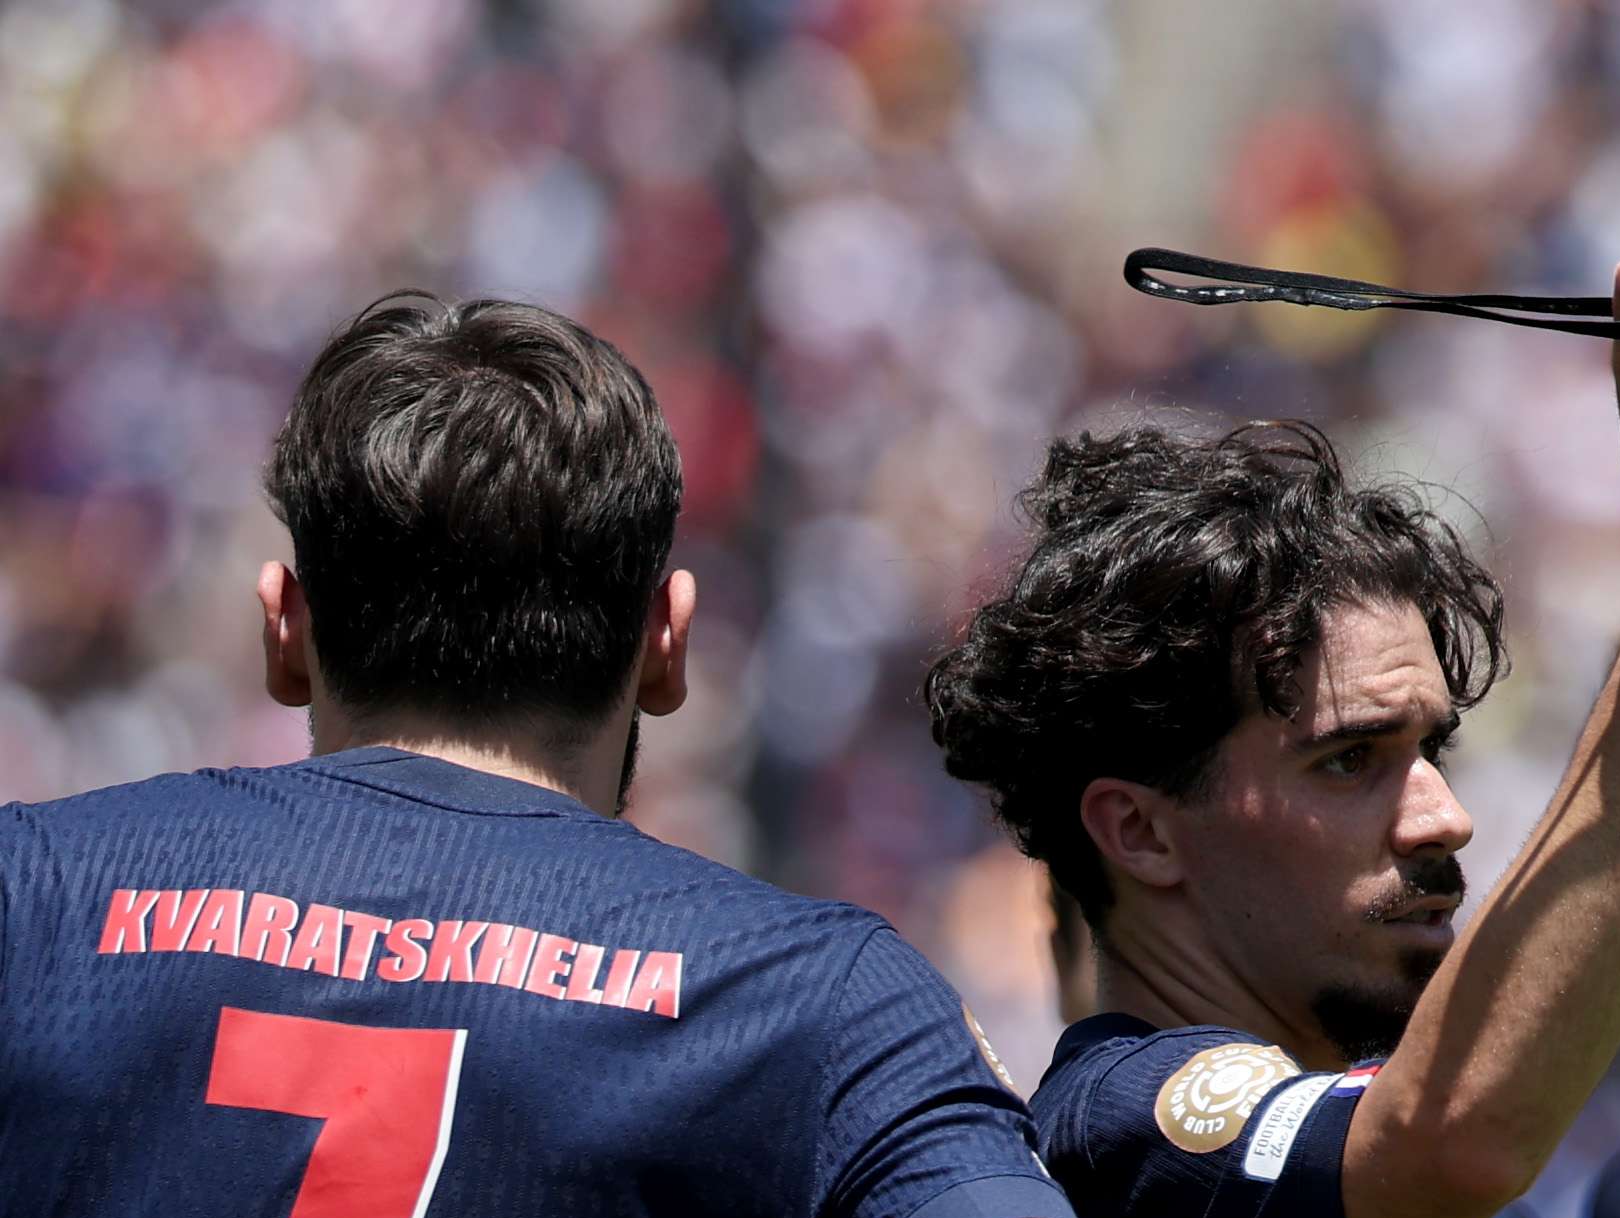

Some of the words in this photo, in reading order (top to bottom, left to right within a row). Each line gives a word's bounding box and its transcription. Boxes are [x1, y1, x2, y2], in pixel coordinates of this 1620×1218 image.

[98, 888, 683, 1019] KVARATSKHELIA
[1170, 1061, 1206, 1121] WORLD
[1183, 1115, 1226, 1135] CLUB
